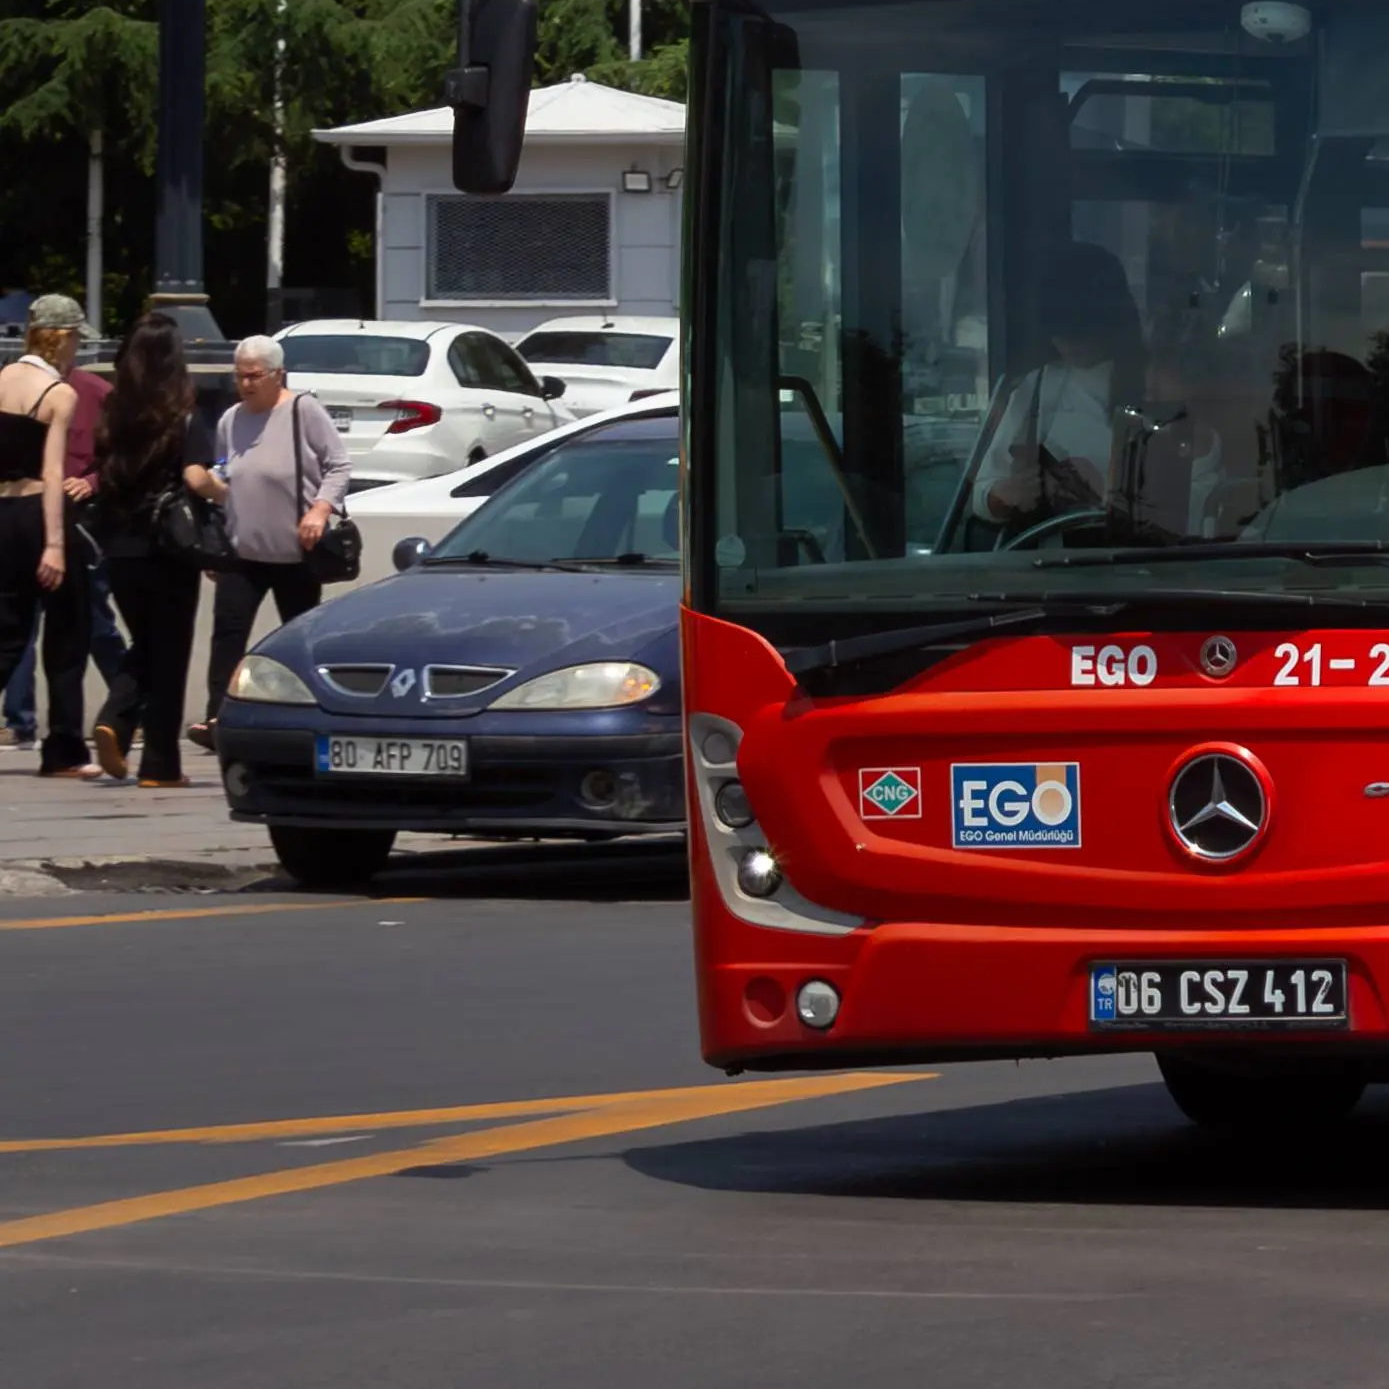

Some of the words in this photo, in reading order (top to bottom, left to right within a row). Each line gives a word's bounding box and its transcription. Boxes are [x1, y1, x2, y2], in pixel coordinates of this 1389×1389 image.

[1071, 645, 1157, 686] EGO
[331, 740, 358, 769] 80
[373, 742, 412, 771] AFP
[421, 743, 463, 771] 709
[872, 785, 909, 801] CNG
[960, 780, 1073, 827] EGO
[960, 831, 983, 842] EGO
[985, 831, 1017, 842] Genel
[1018, 829, 1074, 844] Müdürlüğü
[1098, 998, 1113, 1011] TR
[1118, 971, 1162, 1014] 06
[1180, 970, 1250, 1014] CSZ
[1264, 970, 1334, 1013] 412
